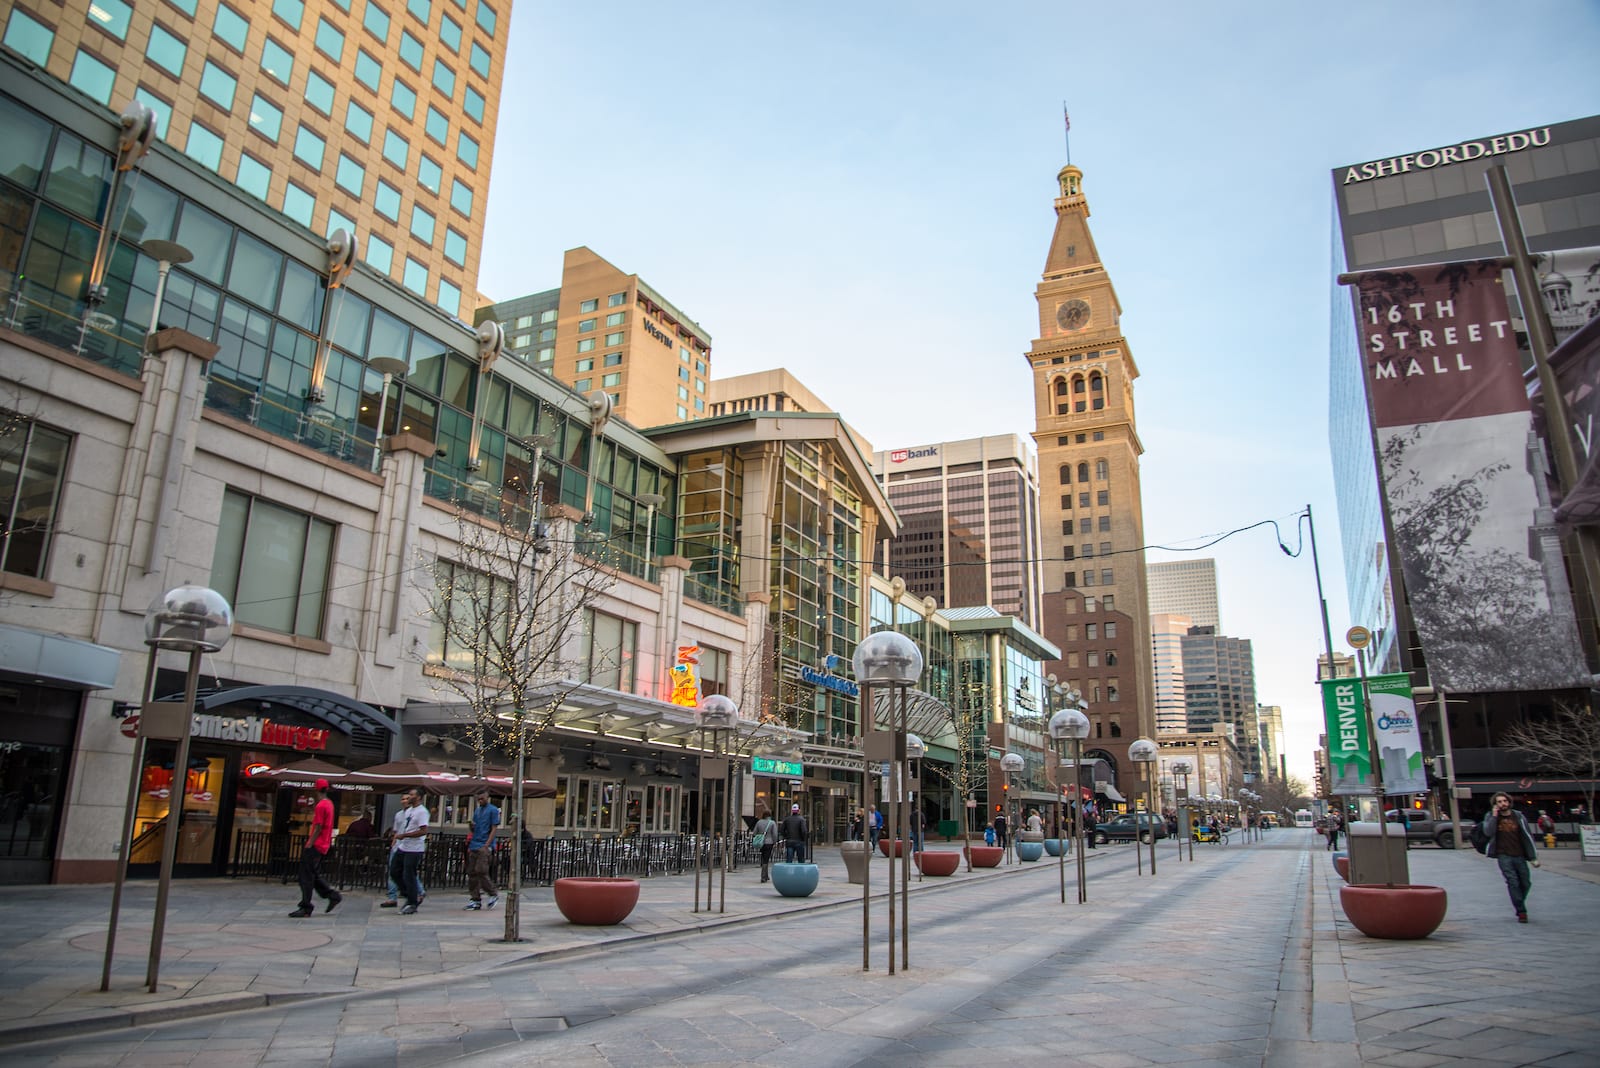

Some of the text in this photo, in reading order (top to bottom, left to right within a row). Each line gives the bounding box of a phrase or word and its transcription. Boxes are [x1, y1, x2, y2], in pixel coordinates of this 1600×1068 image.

[1343, 127, 1551, 185] ASHFORD.EDU
[1368, 299, 1455, 325] 16TH
[643, 316, 673, 350] WESTIN
[1370, 320, 1508, 353] STREET
[1375, 353, 1473, 380] MALL
[1335, 684, 1360, 752] DENVER
